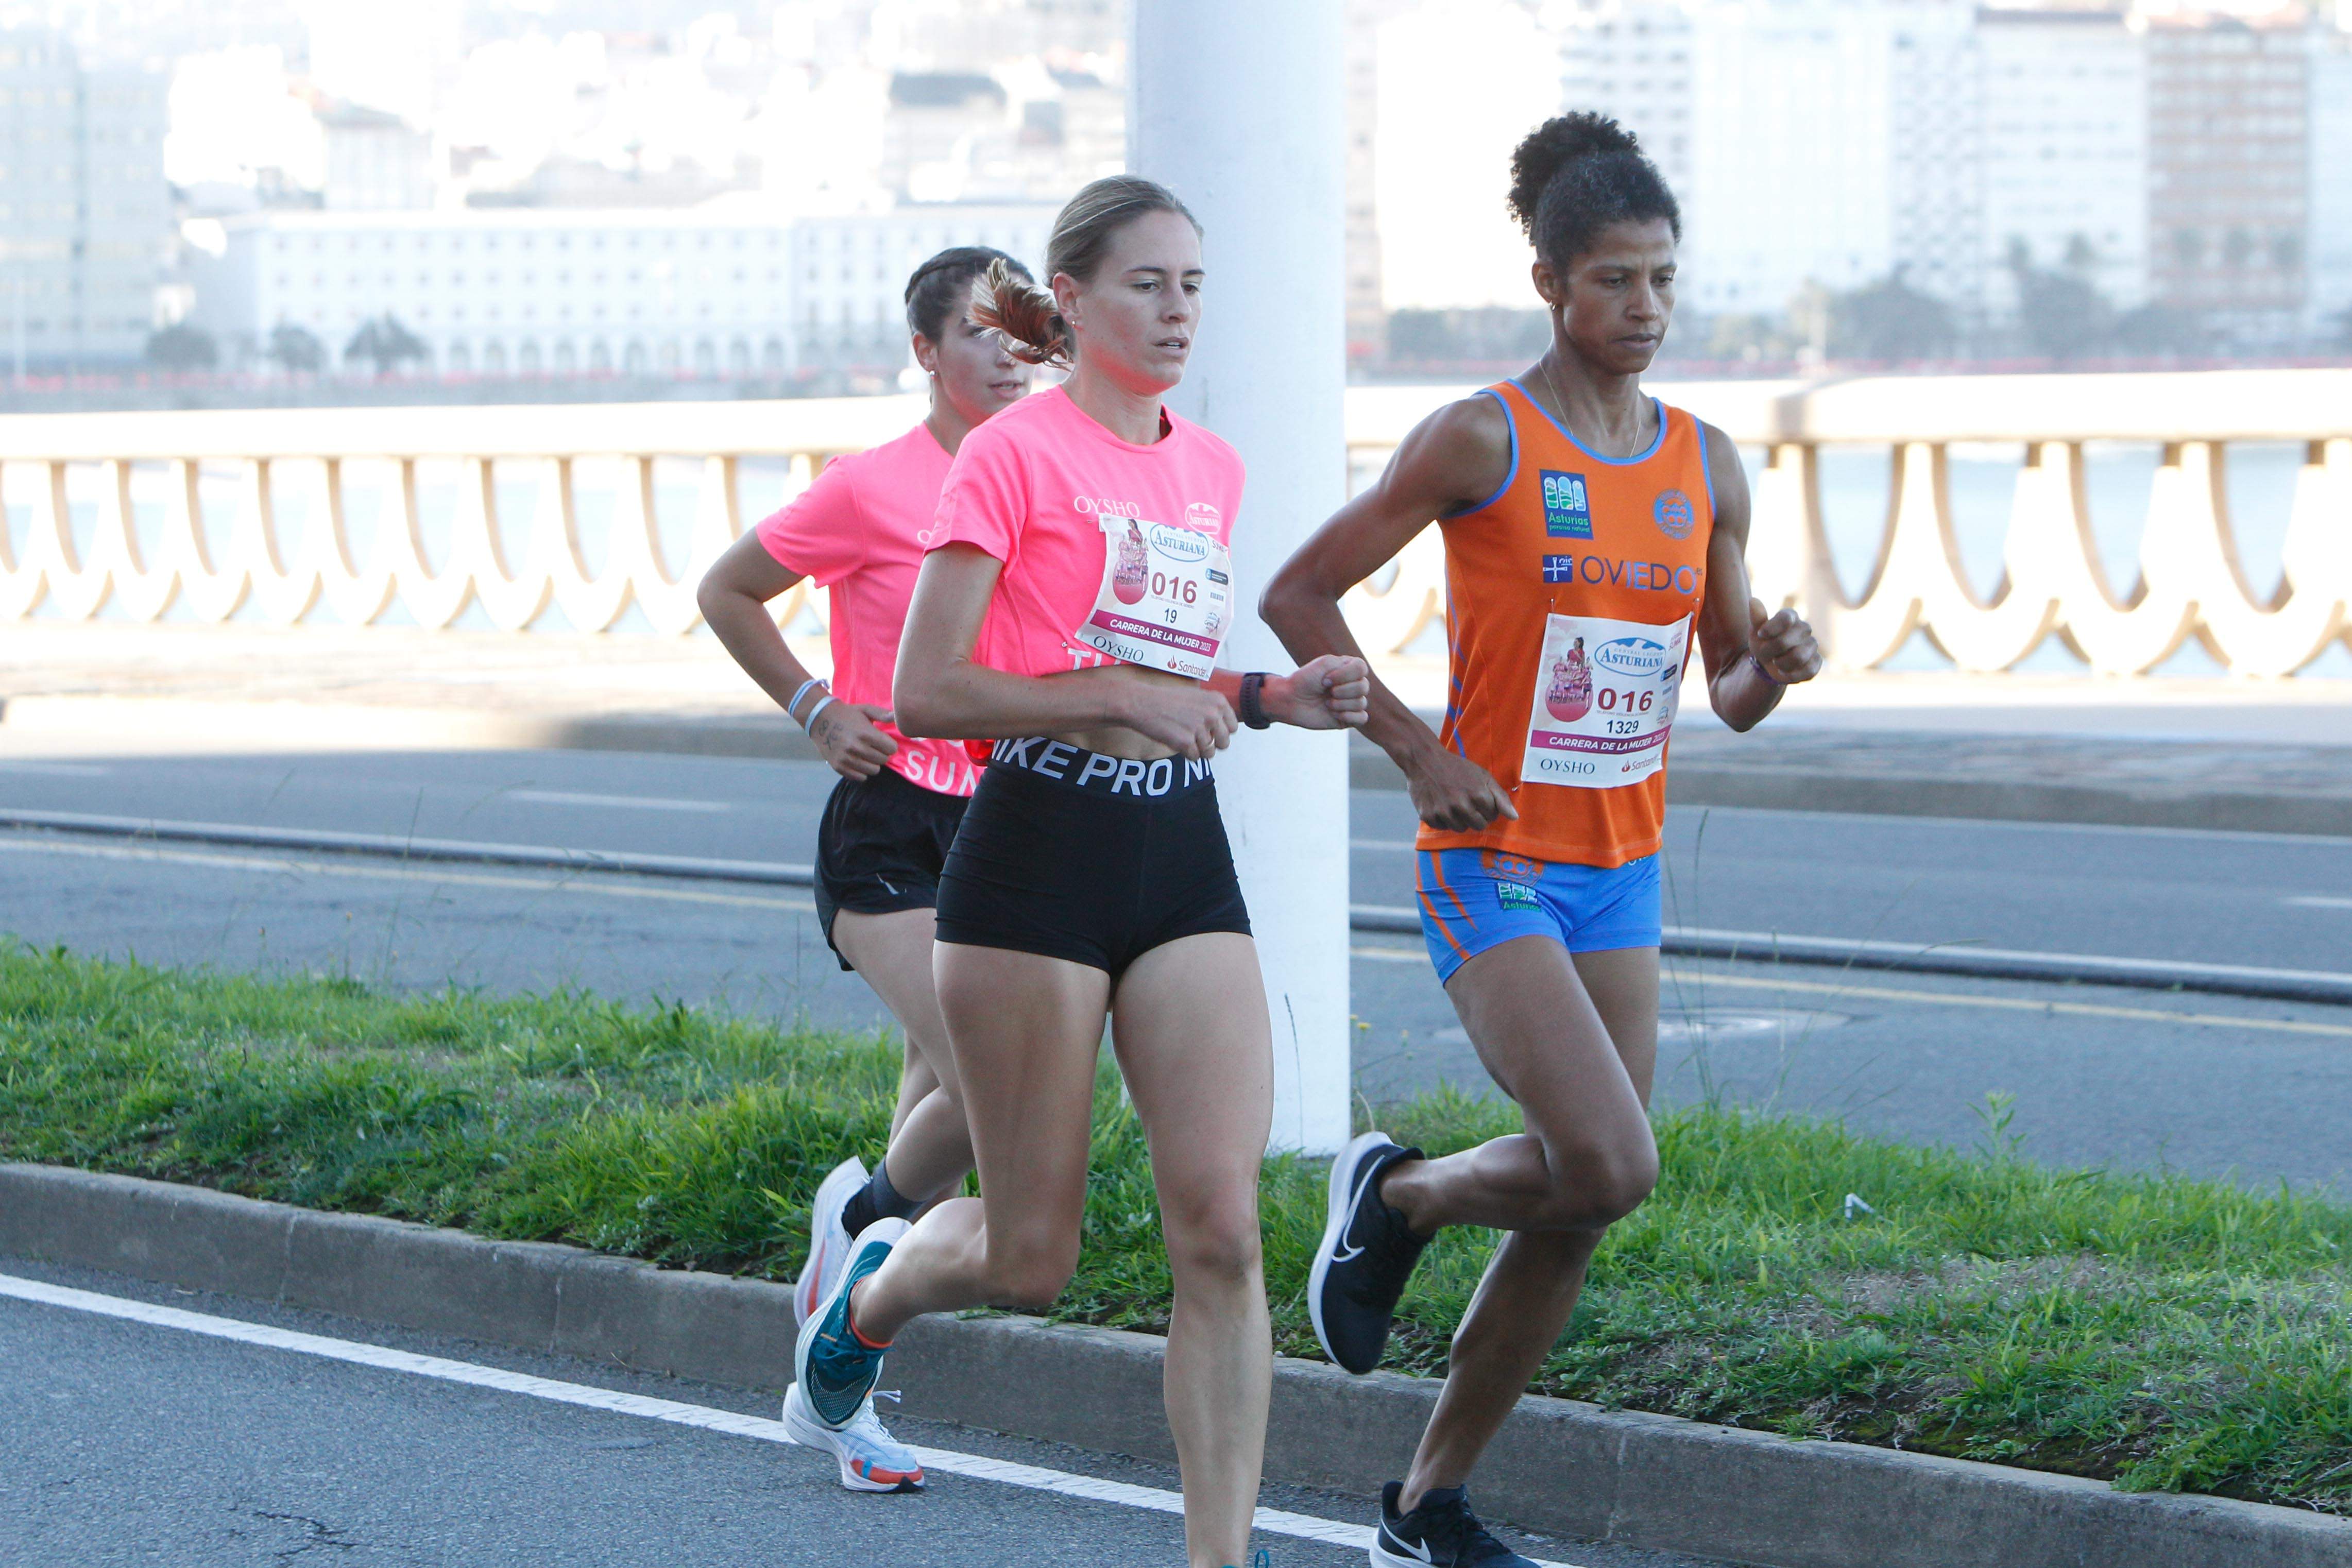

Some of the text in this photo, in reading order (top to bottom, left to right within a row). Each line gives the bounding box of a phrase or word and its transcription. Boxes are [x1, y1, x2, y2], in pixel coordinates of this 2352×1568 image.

[1074, 496, 1140, 518] OYSHO
[1549, 512, 1589, 525] Asturias
[1154, 530, 1205, 556] ASTURIANA
[1581, 556, 1696, 594] OVIEDO
[1152, 572, 1197, 603] 016
[1164, 608, 1177, 623] 19
[1110, 619, 1212, 652] CARRERA DE LA MUJER 2023
[1094, 636, 1144, 662] OYSHO
[1600, 648, 1663, 667] ASTURIANA
[1178, 660, 1206, 677] Santander
[1598, 688, 1654, 712] 016
[1607, 720, 1639, 734] 1329
[1549, 737, 1598, 749] CARRERA
[1601, 742, 1615, 751] DE
[1616, 742, 1627, 751] LA
[1628, 737, 1652, 749] MUJER
[991, 736, 1078, 779] NIKE
[1076, 753, 1173, 796] PRO
[1541, 758, 1595, 774] OYSHO
[1631, 754, 1659, 771] Santan
